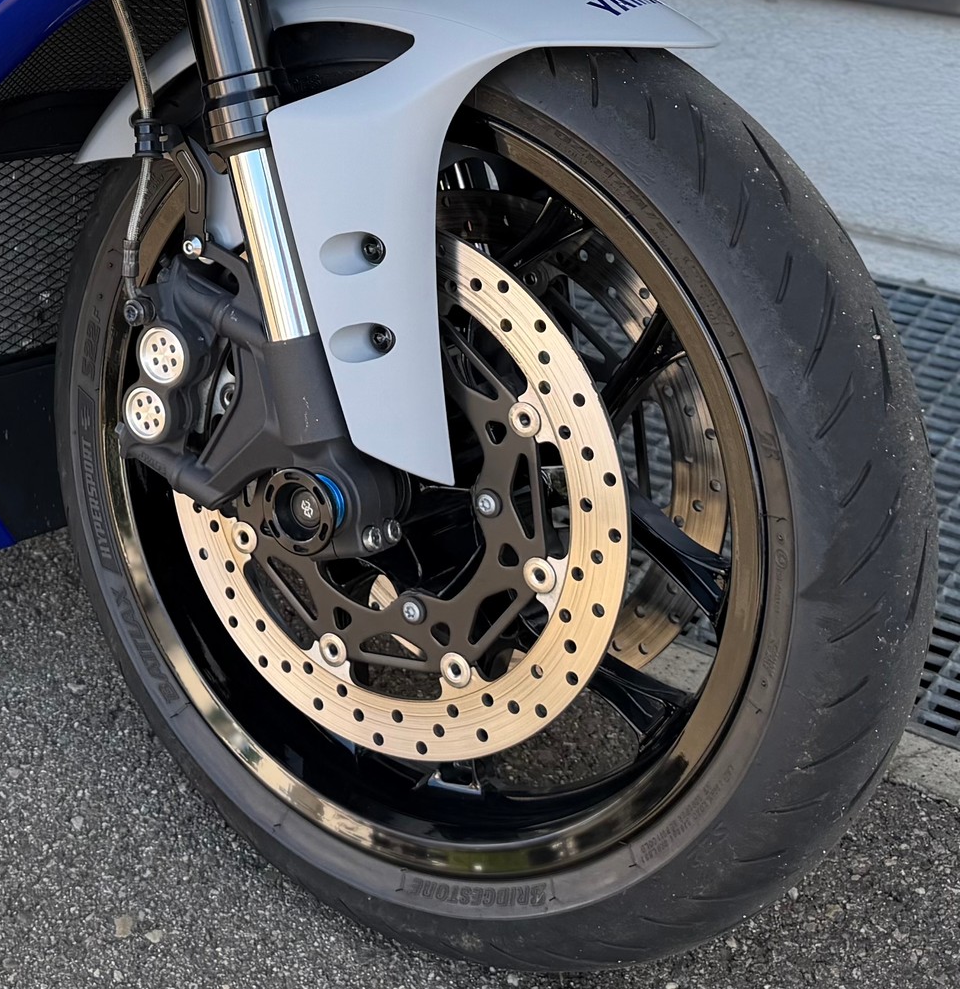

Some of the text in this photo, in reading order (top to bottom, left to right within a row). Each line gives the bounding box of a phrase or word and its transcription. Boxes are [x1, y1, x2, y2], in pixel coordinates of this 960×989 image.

[81, 435, 113, 560] HYPERSPORT
[110, 586, 180, 704] BATTLAX
[408, 877, 547, 907] BRIDGESTONE
